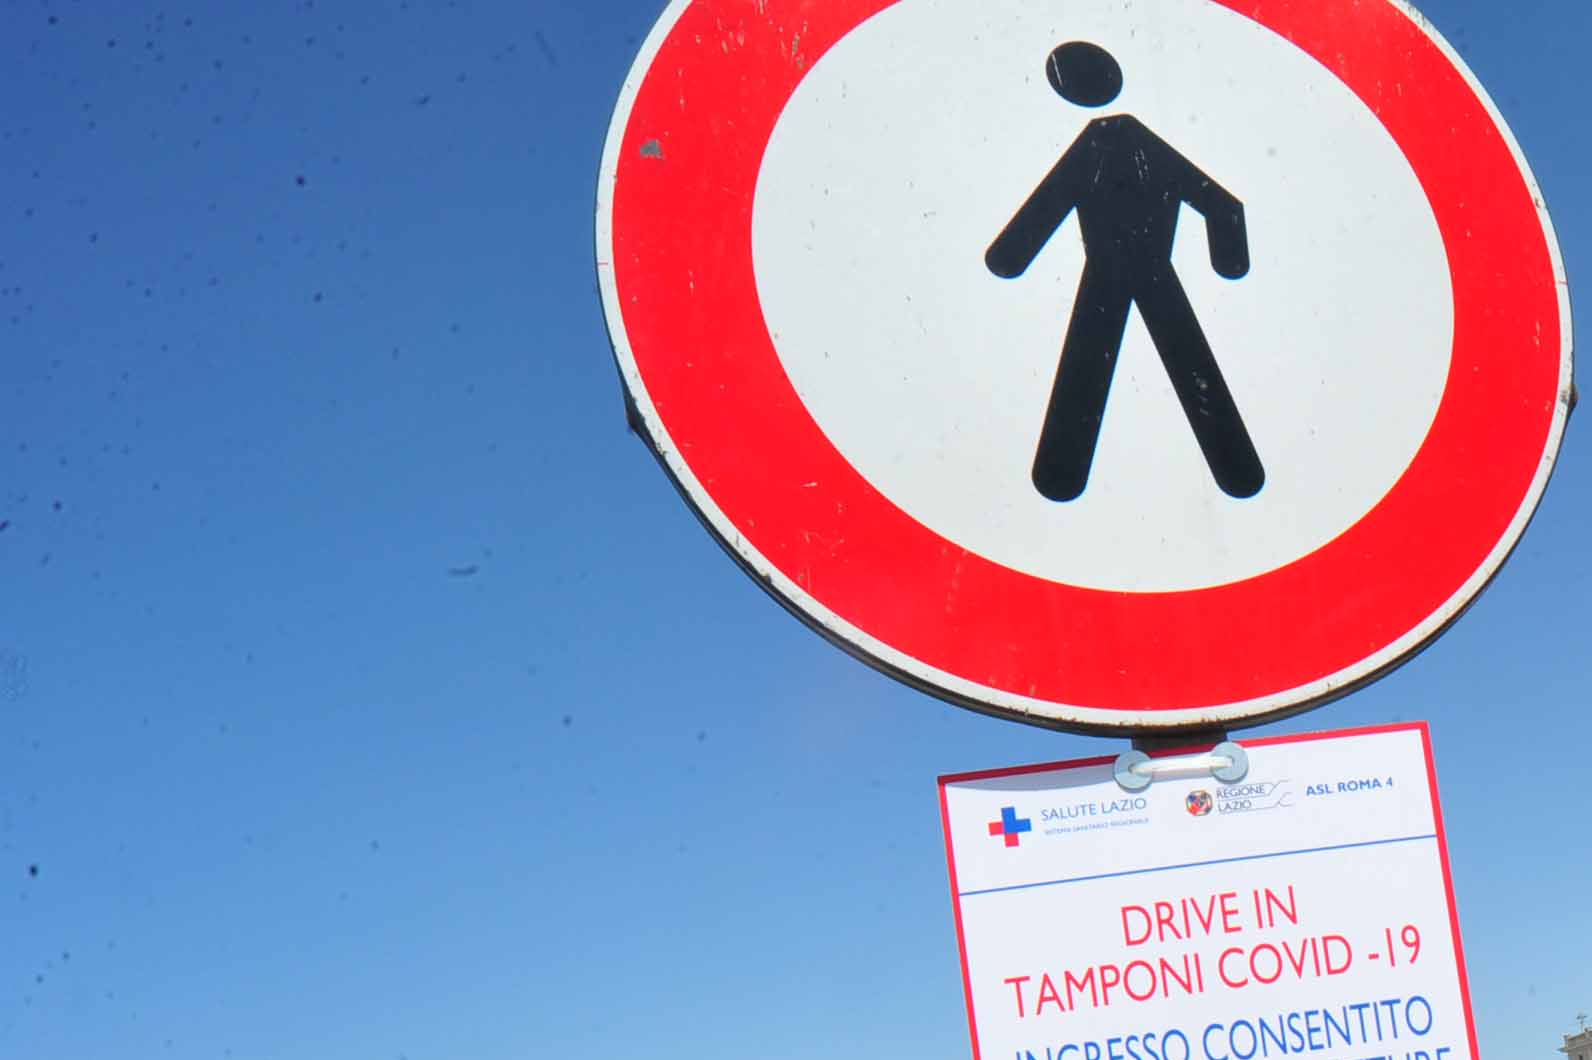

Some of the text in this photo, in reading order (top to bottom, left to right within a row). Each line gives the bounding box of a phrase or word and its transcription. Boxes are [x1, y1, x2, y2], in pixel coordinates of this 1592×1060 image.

[1216, 785, 1265, 799] REGIONE
[1306, 776, 1392, 796] ASL ROMA 4
[1040, 797, 1147, 821] SALUTE LAZIO
[1218, 800, 1252, 812] LAZIO
[1121, 885, 1297, 946] DRIVE IN
[1004, 924, 1420, 1018] TAMPONI COVID -19
